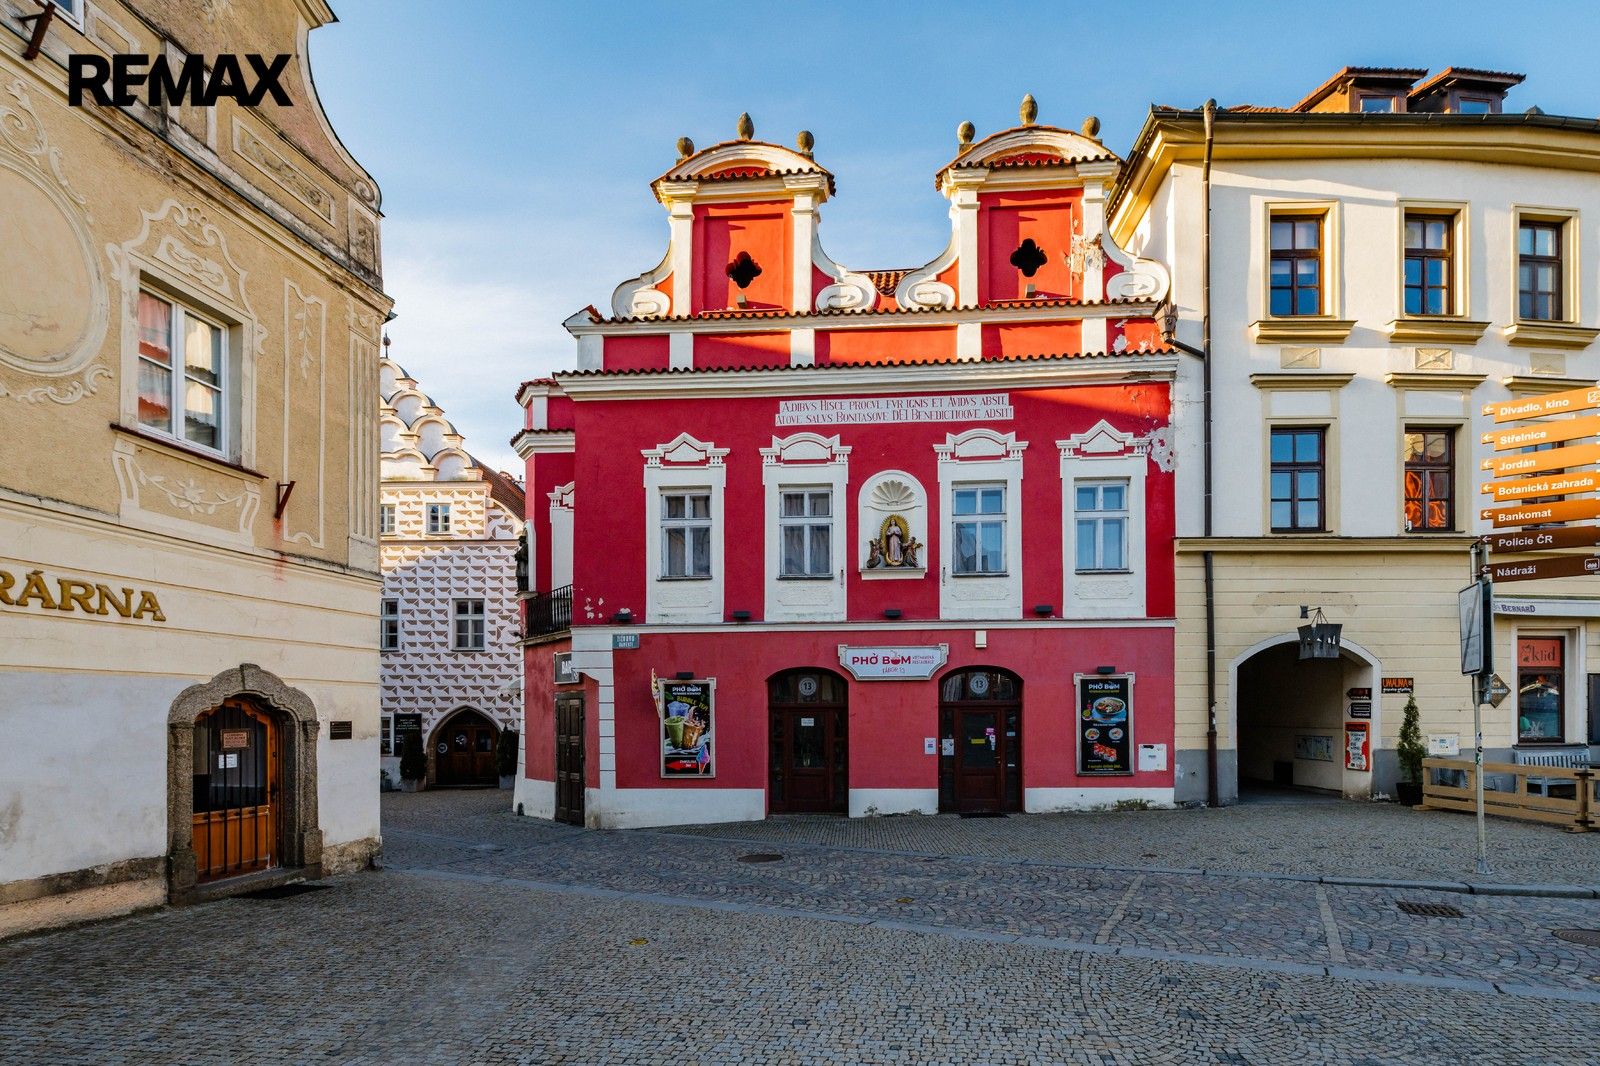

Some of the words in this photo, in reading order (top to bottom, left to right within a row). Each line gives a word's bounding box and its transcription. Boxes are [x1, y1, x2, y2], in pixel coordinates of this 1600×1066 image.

[820, 400, 846, 410] HISCE
[932, 398, 944, 407] ET
[1500, 402, 1542, 416] Divadlo,
[1546, 398, 1569, 410] kino
[1500, 430, 1547, 445] Střelnice
[1499, 458, 1536, 471] Jordán
[1498, 482, 1548, 496] Botanická
[1551, 477, 1594, 490] zahrada
[1498, 509, 1552, 522] Bankomat
[1499, 537, 1534, 547] Policie
[1537, 534, 1553, 544] ČR
[1497, 565, 1536, 577] Nádraží
[1501, 604, 1536, 613] BERNARD
[1532, 646, 1556, 662] klid
[804, 682, 812, 690] 13
